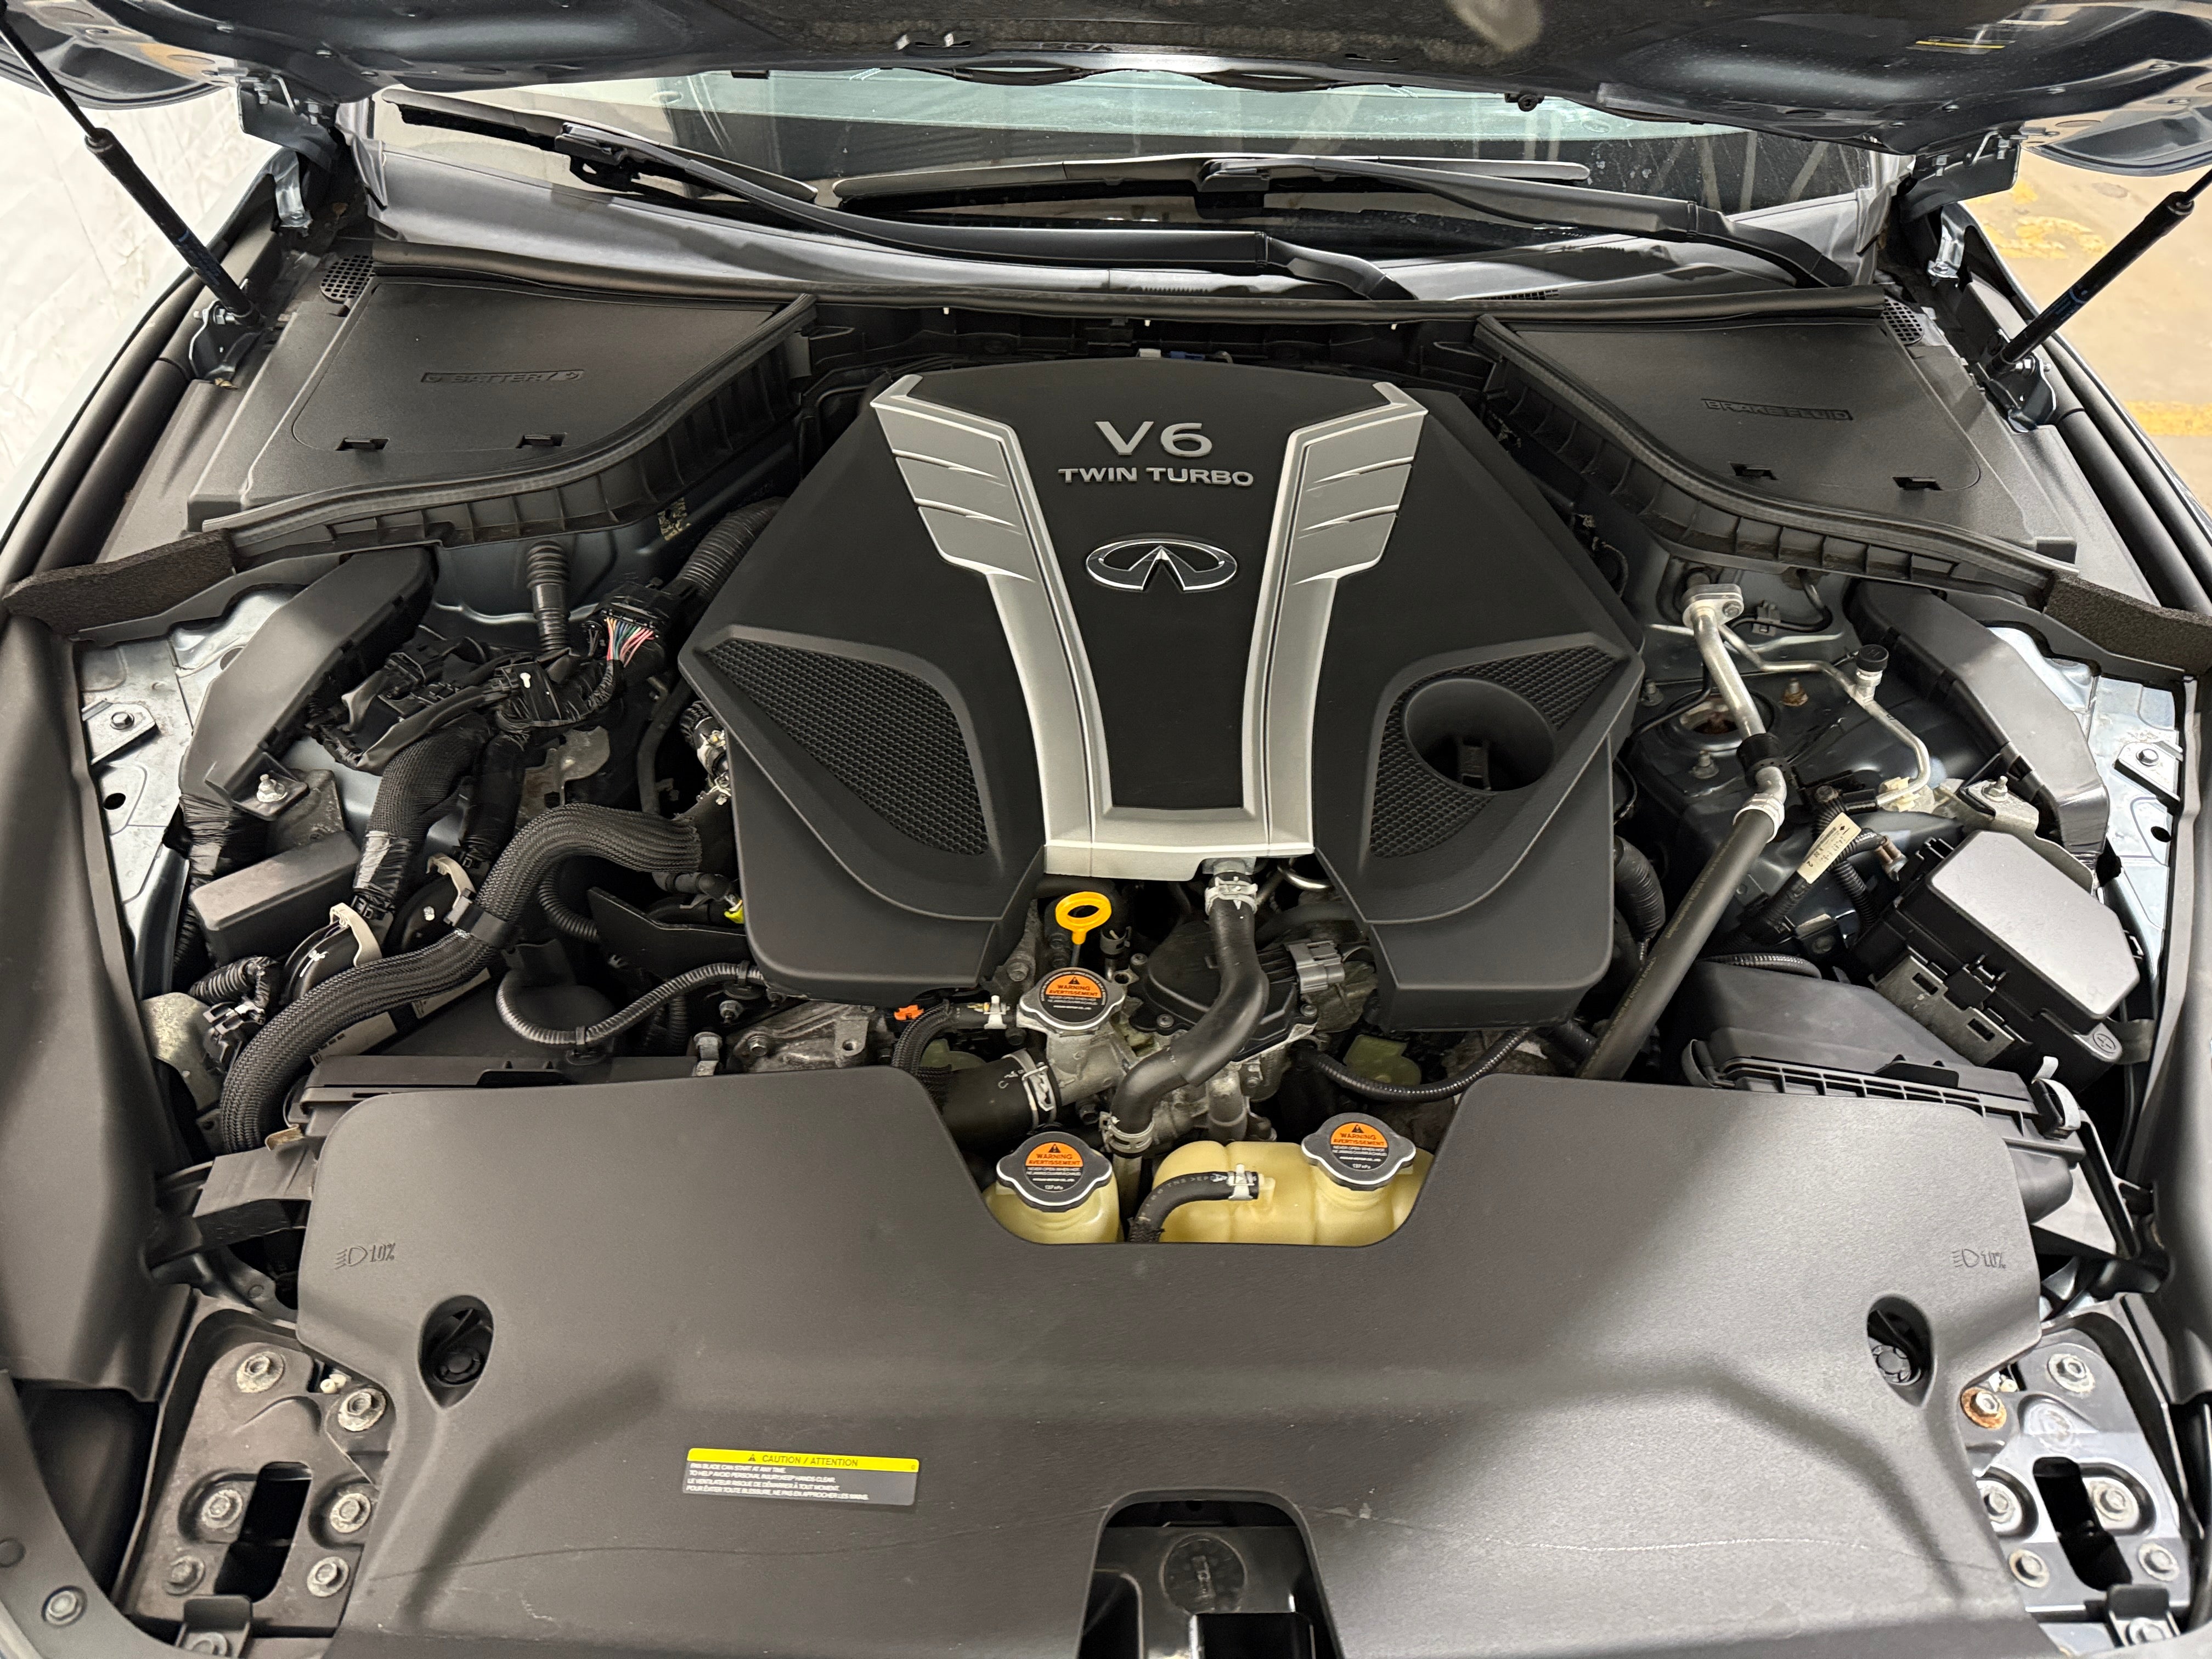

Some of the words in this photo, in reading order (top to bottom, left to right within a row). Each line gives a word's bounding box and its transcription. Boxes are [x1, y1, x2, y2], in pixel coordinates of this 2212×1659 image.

[1703, 400, 1780, 415] BRAKE
[1786, 408, 1850, 420] FLUID
[1094, 421, 1212, 457] V6
[1058, 467, 1137, 483] TWIN
[1146, 467, 1254, 487] TURBO
[762, 1454, 802, 1464] CAUTION
[810, 1457, 859, 1466] ATTENTION
